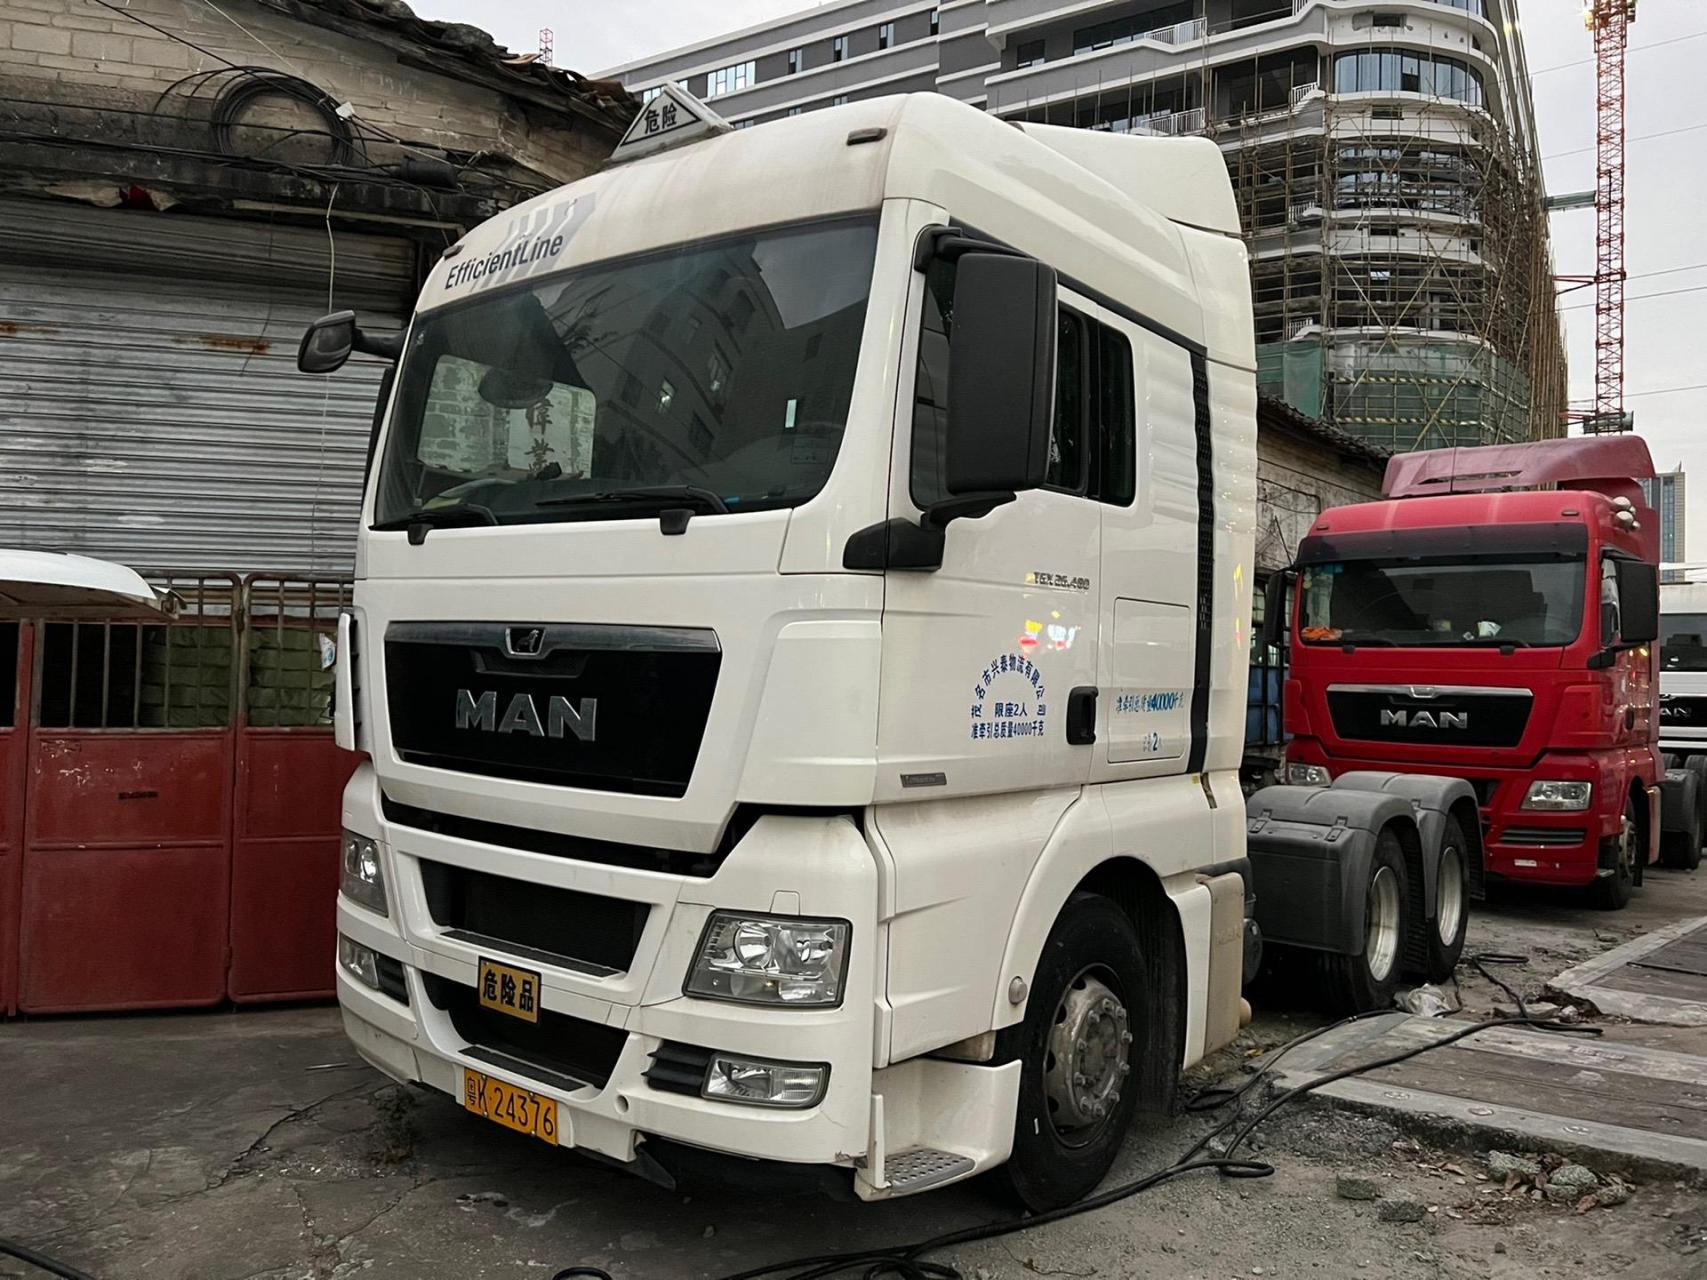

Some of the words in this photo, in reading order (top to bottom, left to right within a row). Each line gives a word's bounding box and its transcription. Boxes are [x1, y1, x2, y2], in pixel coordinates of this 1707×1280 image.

[644, 102, 677, 134] 危险
[445, 235, 563, 290] EfficientLine
[456, 689, 597, 741] MAN
[994, 701, 1028, 718] 限座2人
[1381, 709, 1468, 729] MAN
[1659, 707, 1692, 718] AN
[483, 969, 535, 1013] 危险品
